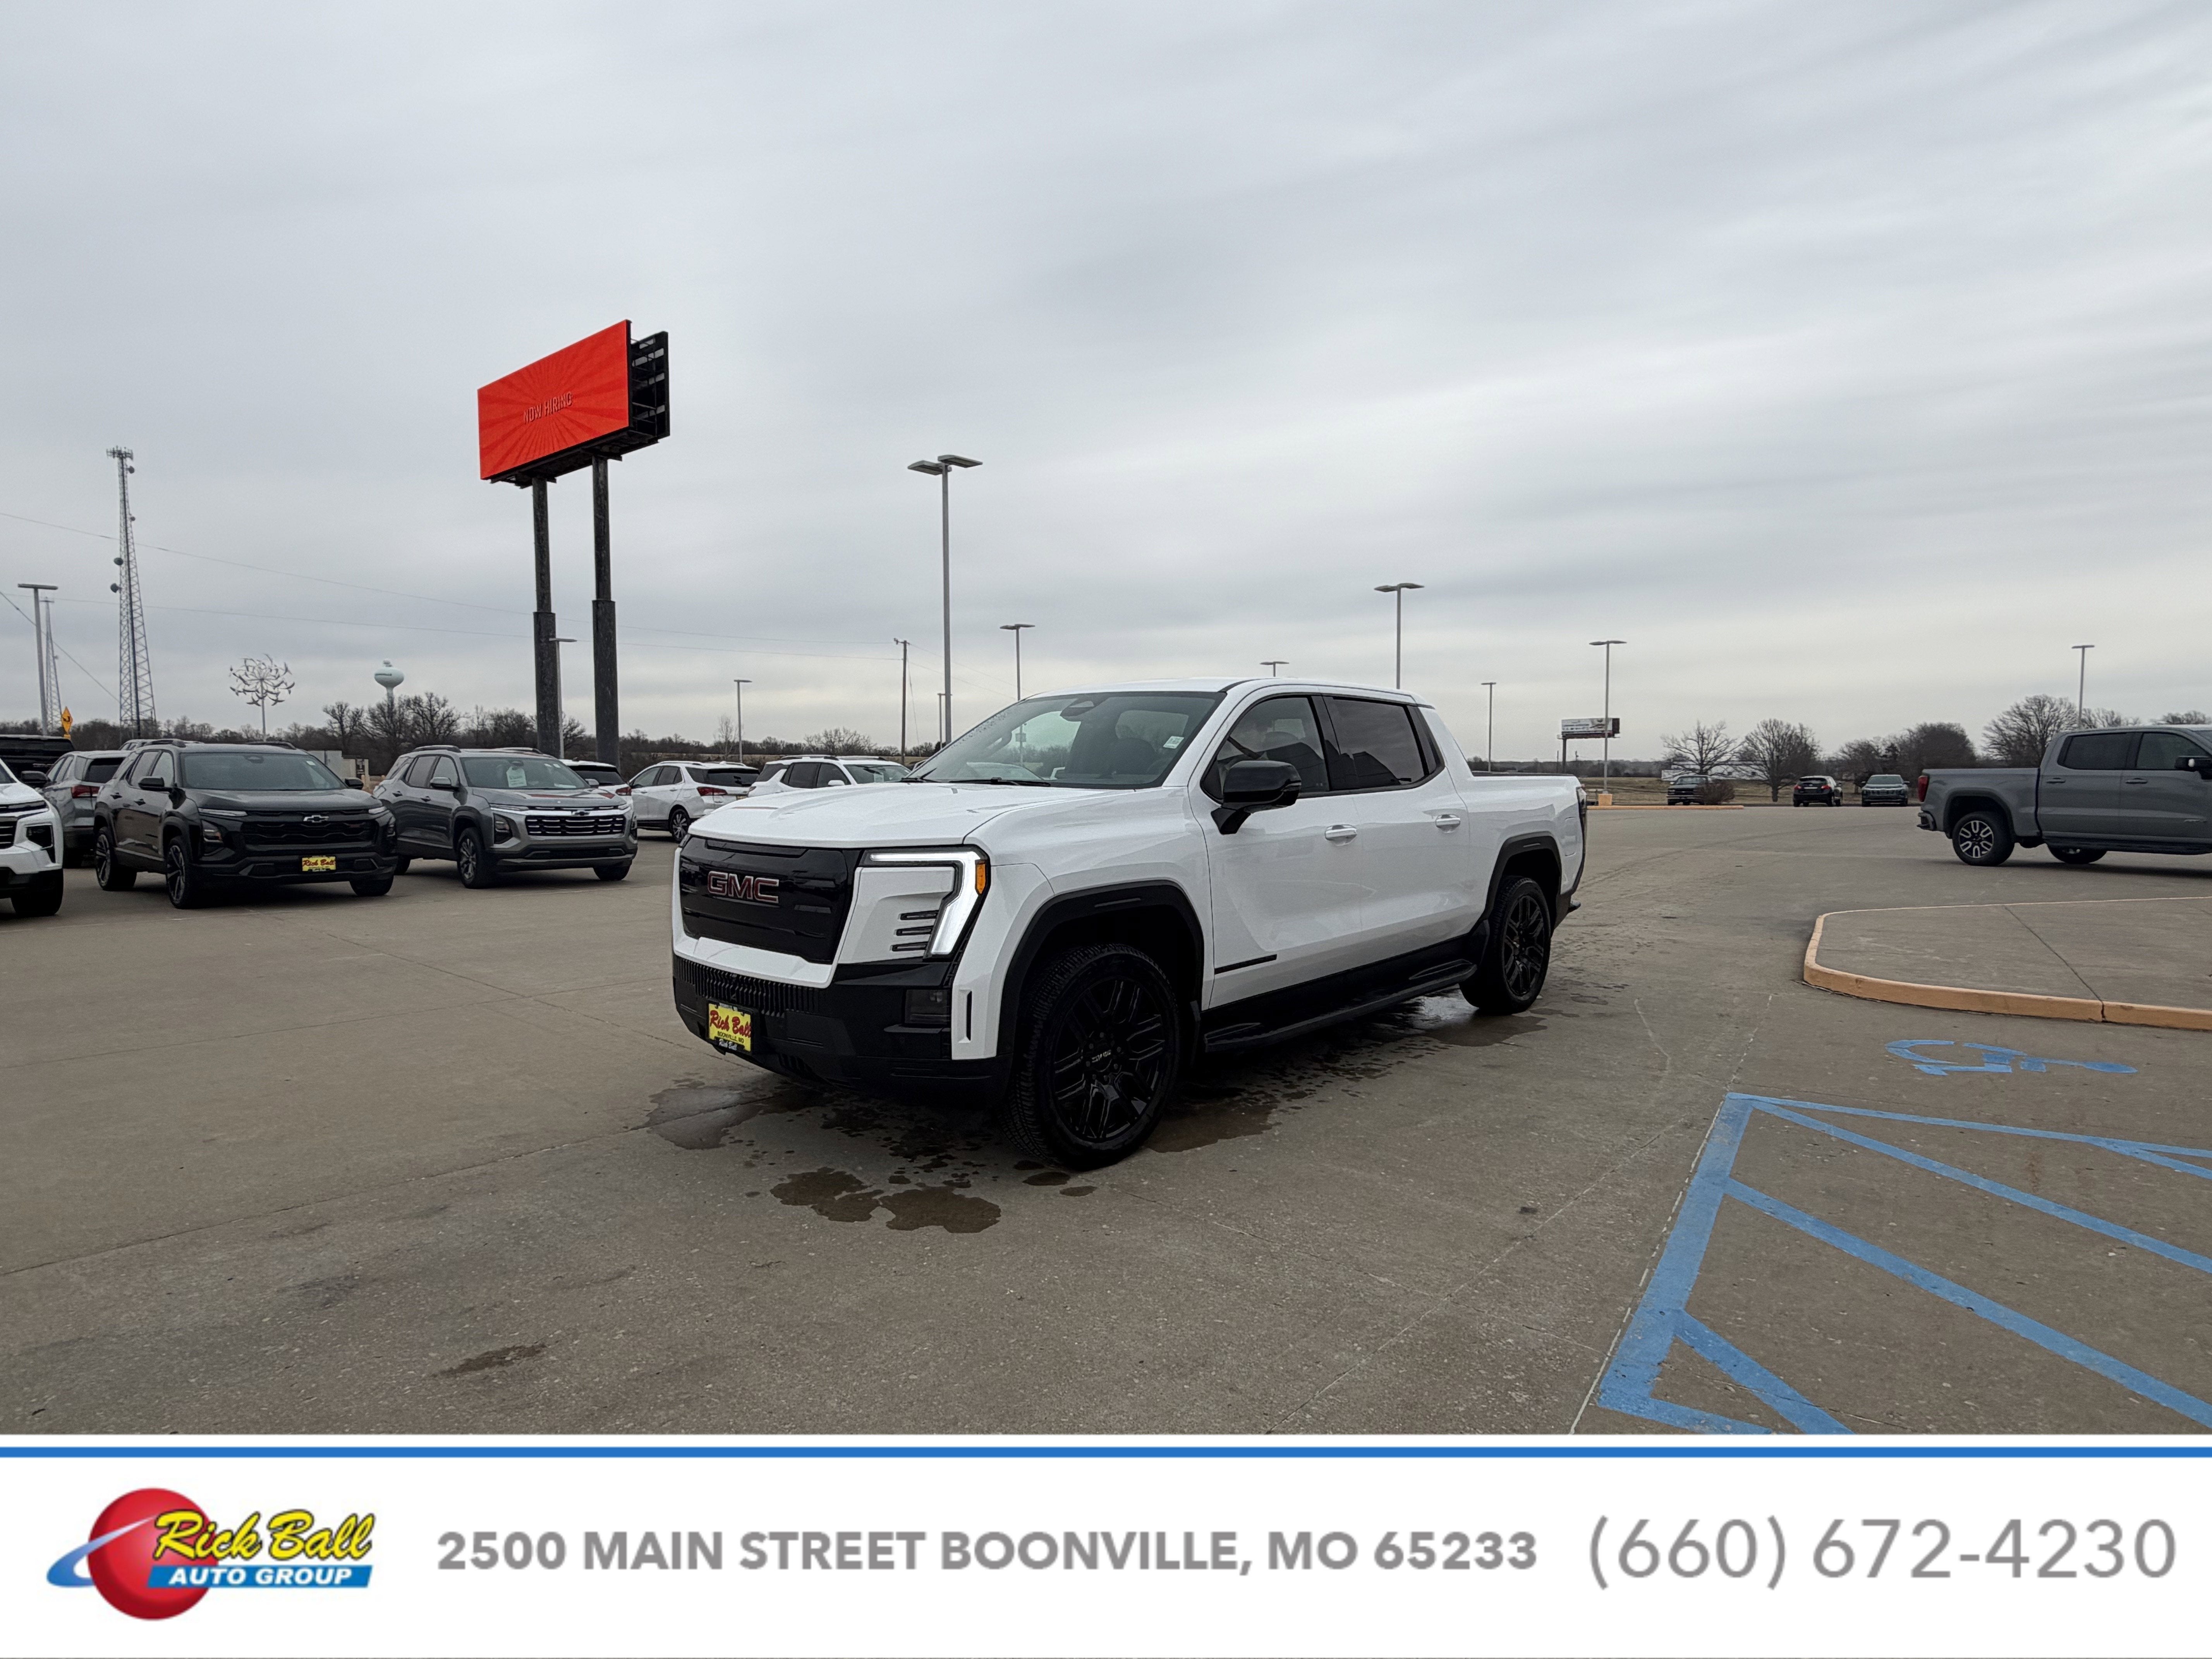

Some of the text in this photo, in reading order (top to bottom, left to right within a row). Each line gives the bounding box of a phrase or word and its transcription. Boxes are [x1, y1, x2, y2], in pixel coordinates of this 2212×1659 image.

[524, 391, 572, 424] NOW HIRING
[708, 871, 779, 904] GMC
[709, 1010, 730, 1032] Rick
